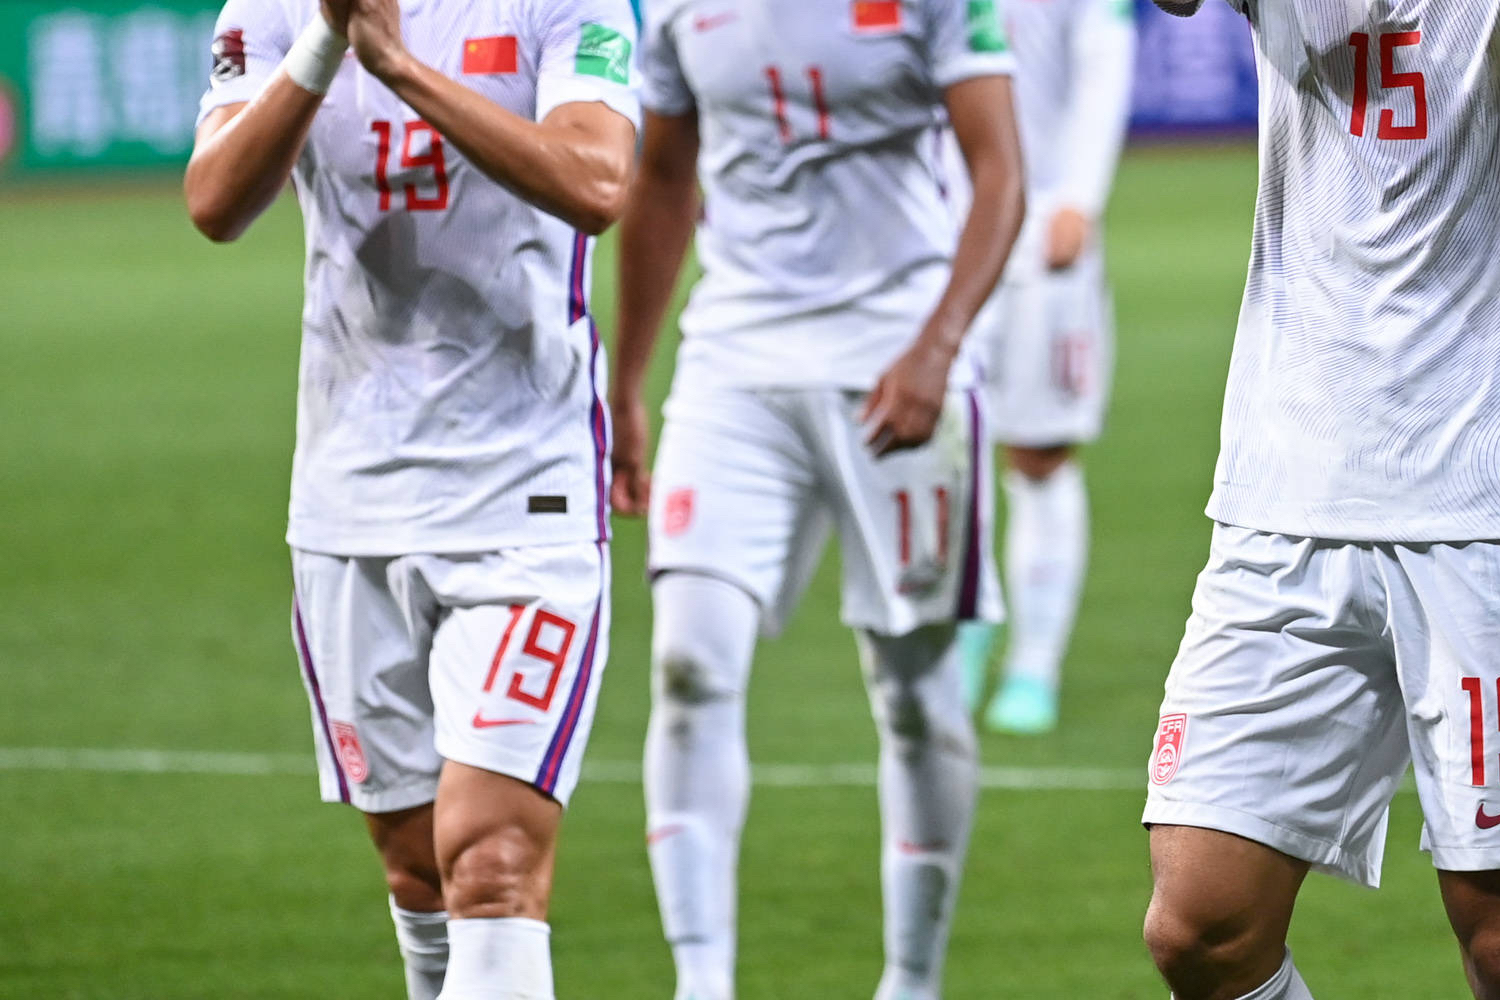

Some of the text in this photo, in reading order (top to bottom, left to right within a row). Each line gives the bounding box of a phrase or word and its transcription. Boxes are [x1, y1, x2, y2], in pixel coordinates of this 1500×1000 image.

[766, 66, 830, 142] 11
[1350, 31, 1428, 140] 15
[371, 121, 449, 211] 19
[896, 486, 948, 567] 11
[482, 604, 577, 713] 19
[1161, 719, 1183, 735] CFA
